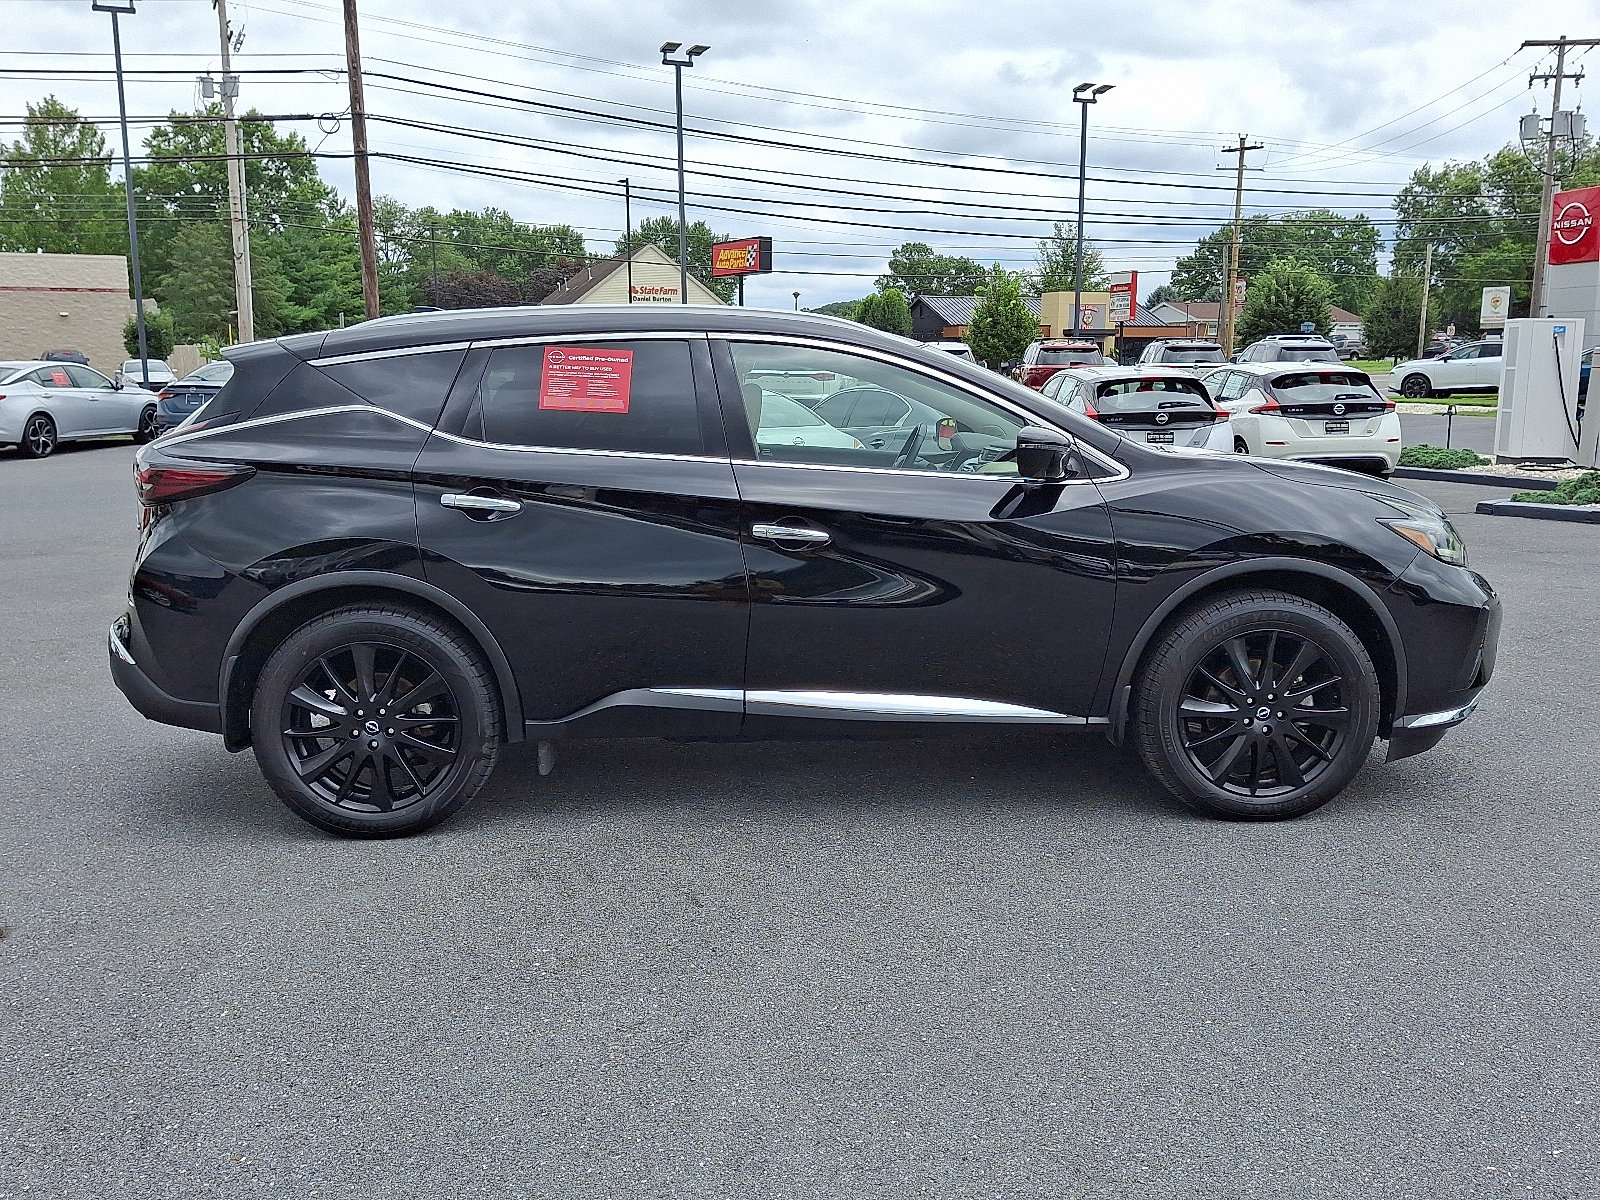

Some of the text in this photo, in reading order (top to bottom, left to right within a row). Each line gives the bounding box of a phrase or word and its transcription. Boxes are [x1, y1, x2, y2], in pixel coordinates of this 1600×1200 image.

[1553, 217, 1593, 230] NISSAN
[719, 248, 748, 260] Advance
[715, 260, 730, 268] Auto
[639, 286, 678, 295] State Farm
